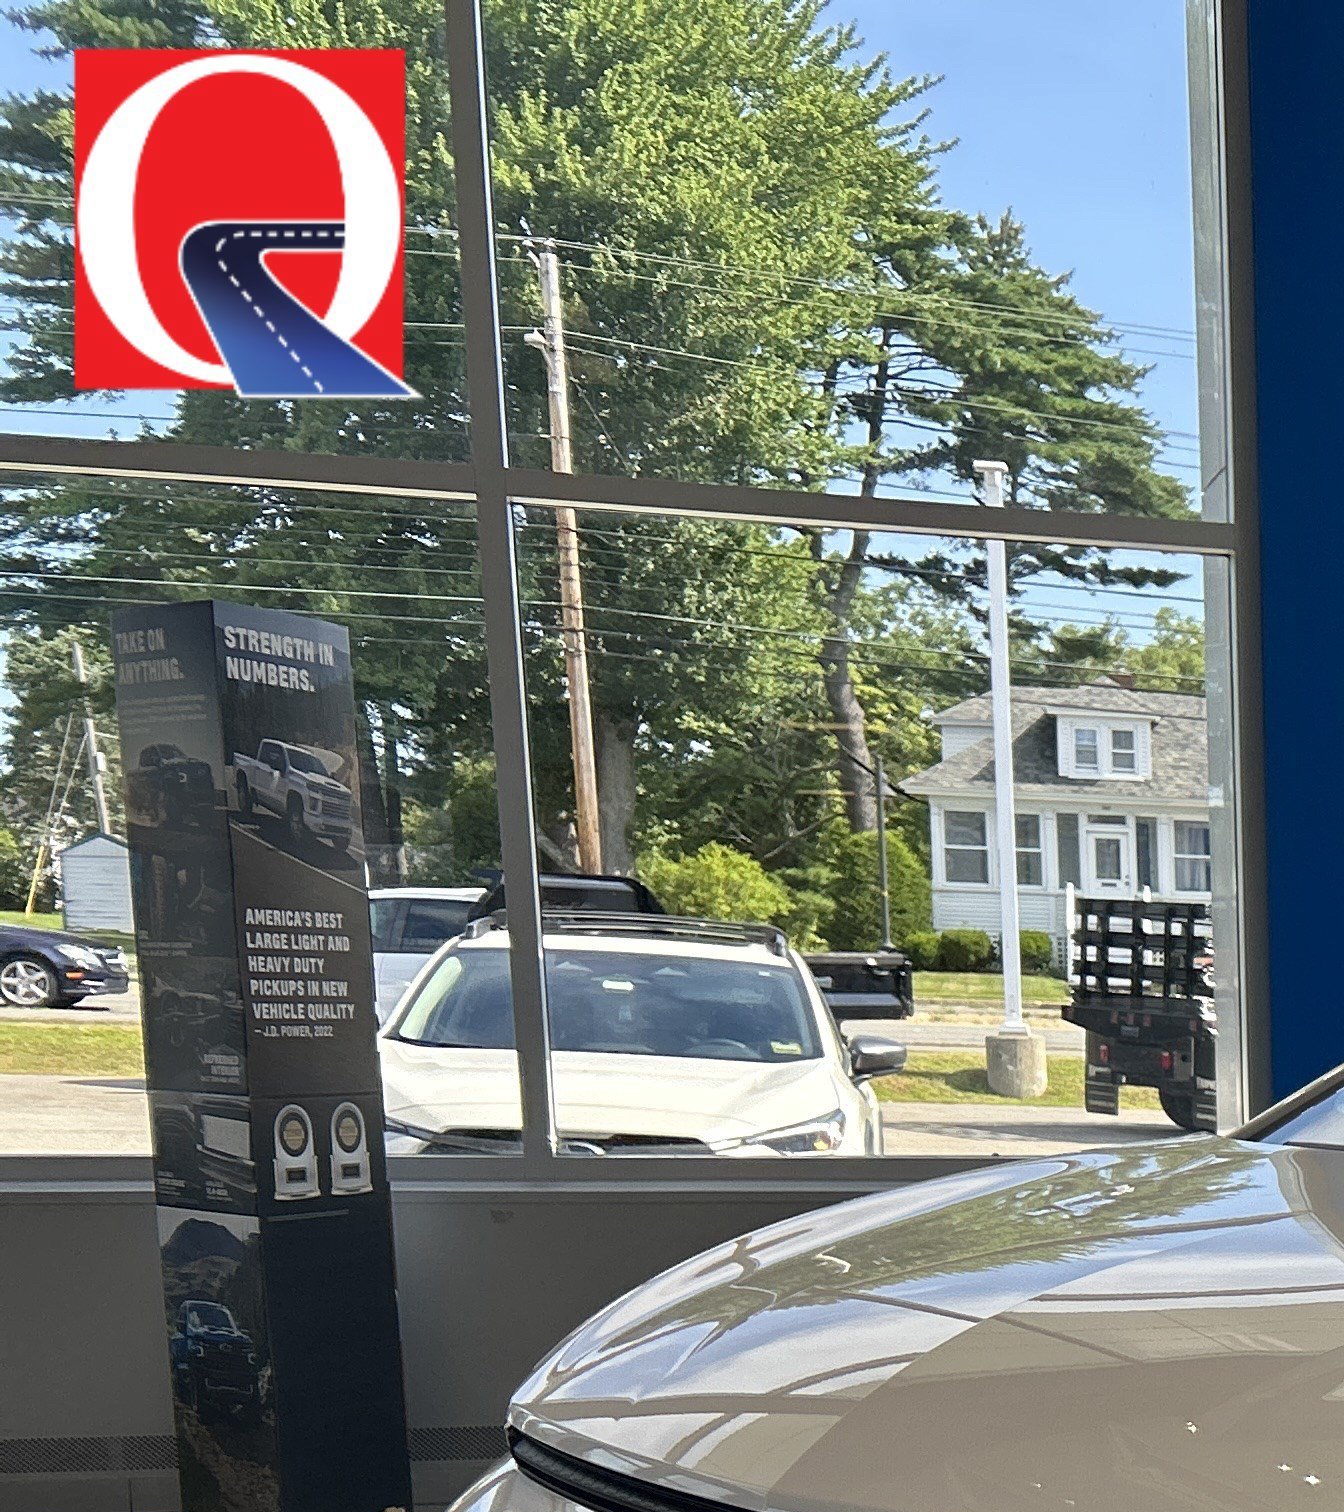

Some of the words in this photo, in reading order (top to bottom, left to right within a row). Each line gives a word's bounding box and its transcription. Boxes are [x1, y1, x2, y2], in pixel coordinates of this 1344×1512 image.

[115, 629, 145, 654] TAKE
[147, 627, 165, 651] ON
[224, 625, 315, 663] STRENGTH
[318, 642, 334, 667] IN
[119, 656, 185, 685] ANYTHING.
[225, 656, 316, 693] NUMBERS.
[245, 908, 313, 928] AMERICA'S
[315, 911, 343, 929] BEST
[245, 931, 289, 949] LARGE
[290, 934, 324, 951] LIGHT
[327, 936, 350, 952] AND
[248, 955, 290, 973] HEAVY
[293, 957, 325, 974] DUTY
[250, 979, 304, 996] PICKUPS
[307, 980, 320, 996] IN
[322, 981, 348, 997] NEW
[252, 1002, 305, 1019] VEHICLE
[307, 1003, 355, 1020] QUALITY
